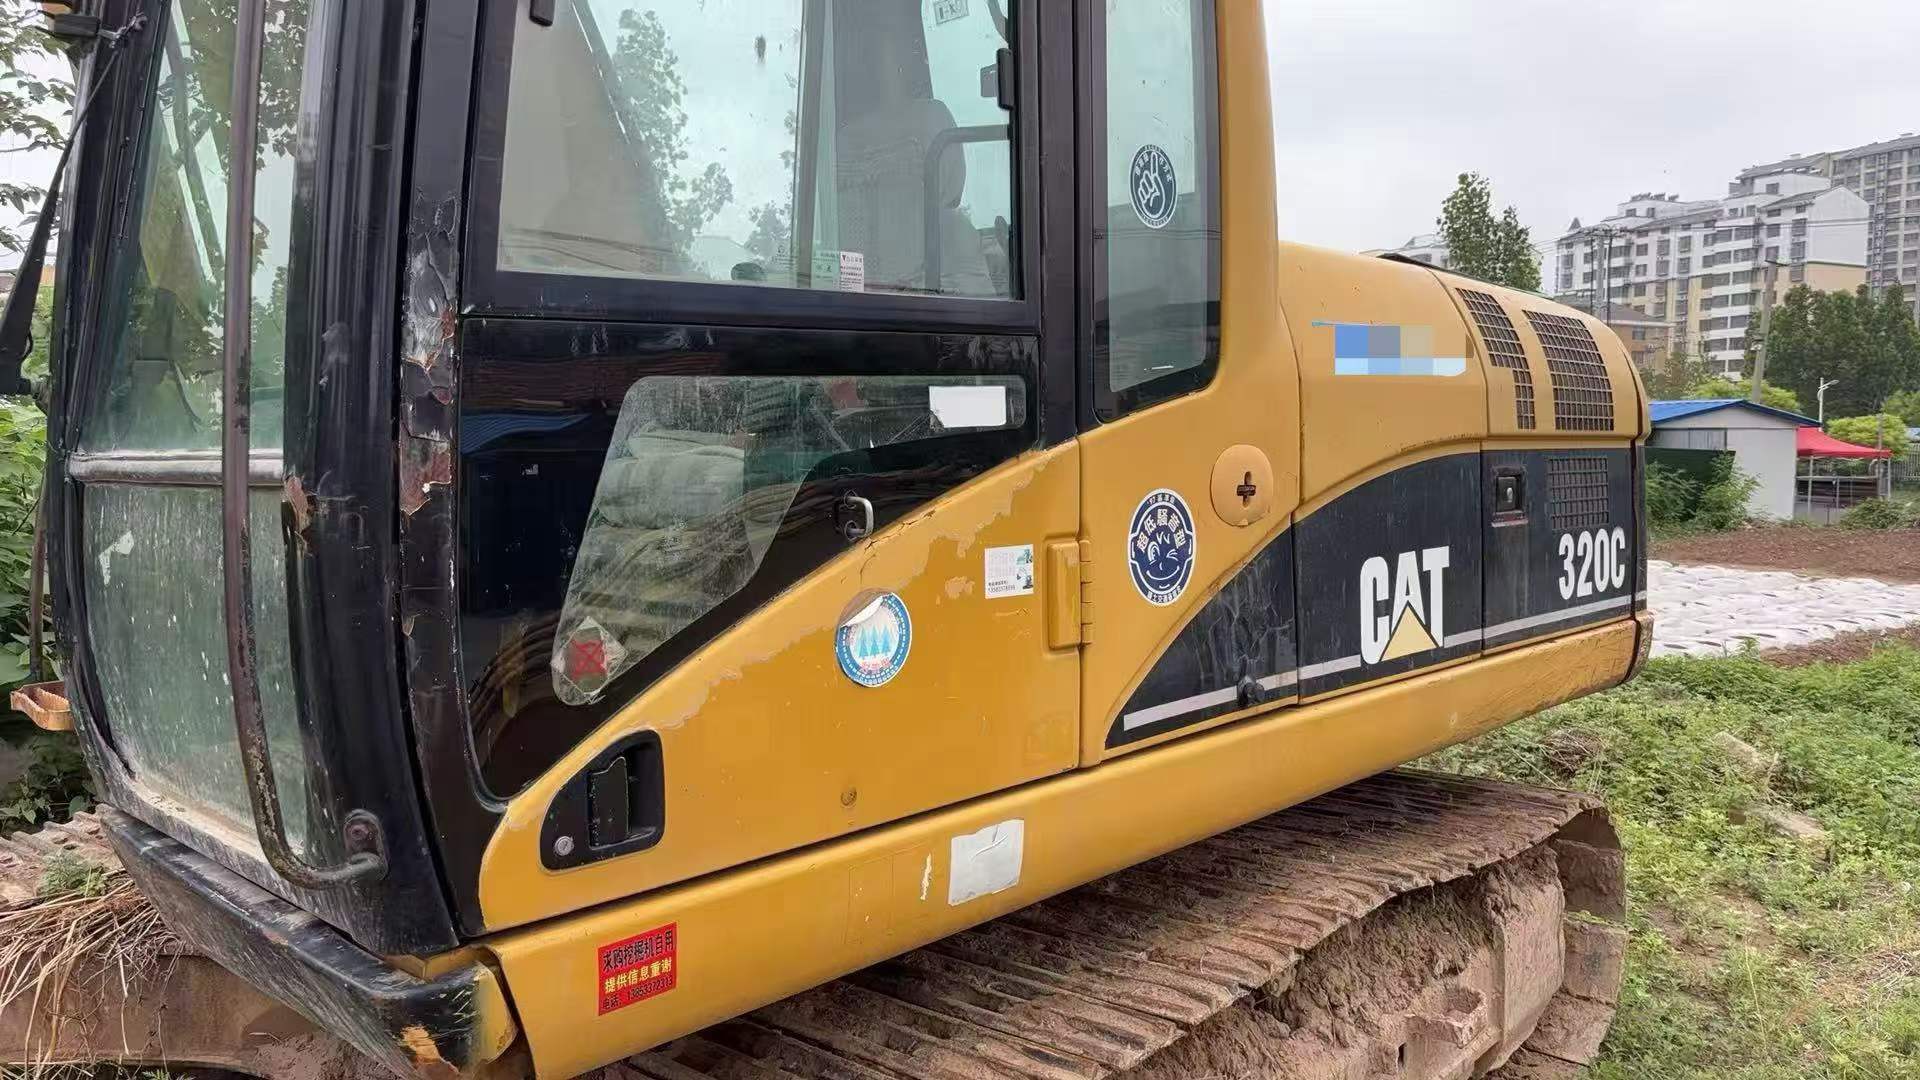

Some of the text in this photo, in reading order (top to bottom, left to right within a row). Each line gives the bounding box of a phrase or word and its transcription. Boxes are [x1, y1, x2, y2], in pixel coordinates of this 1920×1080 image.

[1558, 526, 1626, 600] 320C
[1360, 546, 1449, 664] CAT
[605, 957, 672, 994] 提供信息重谢
